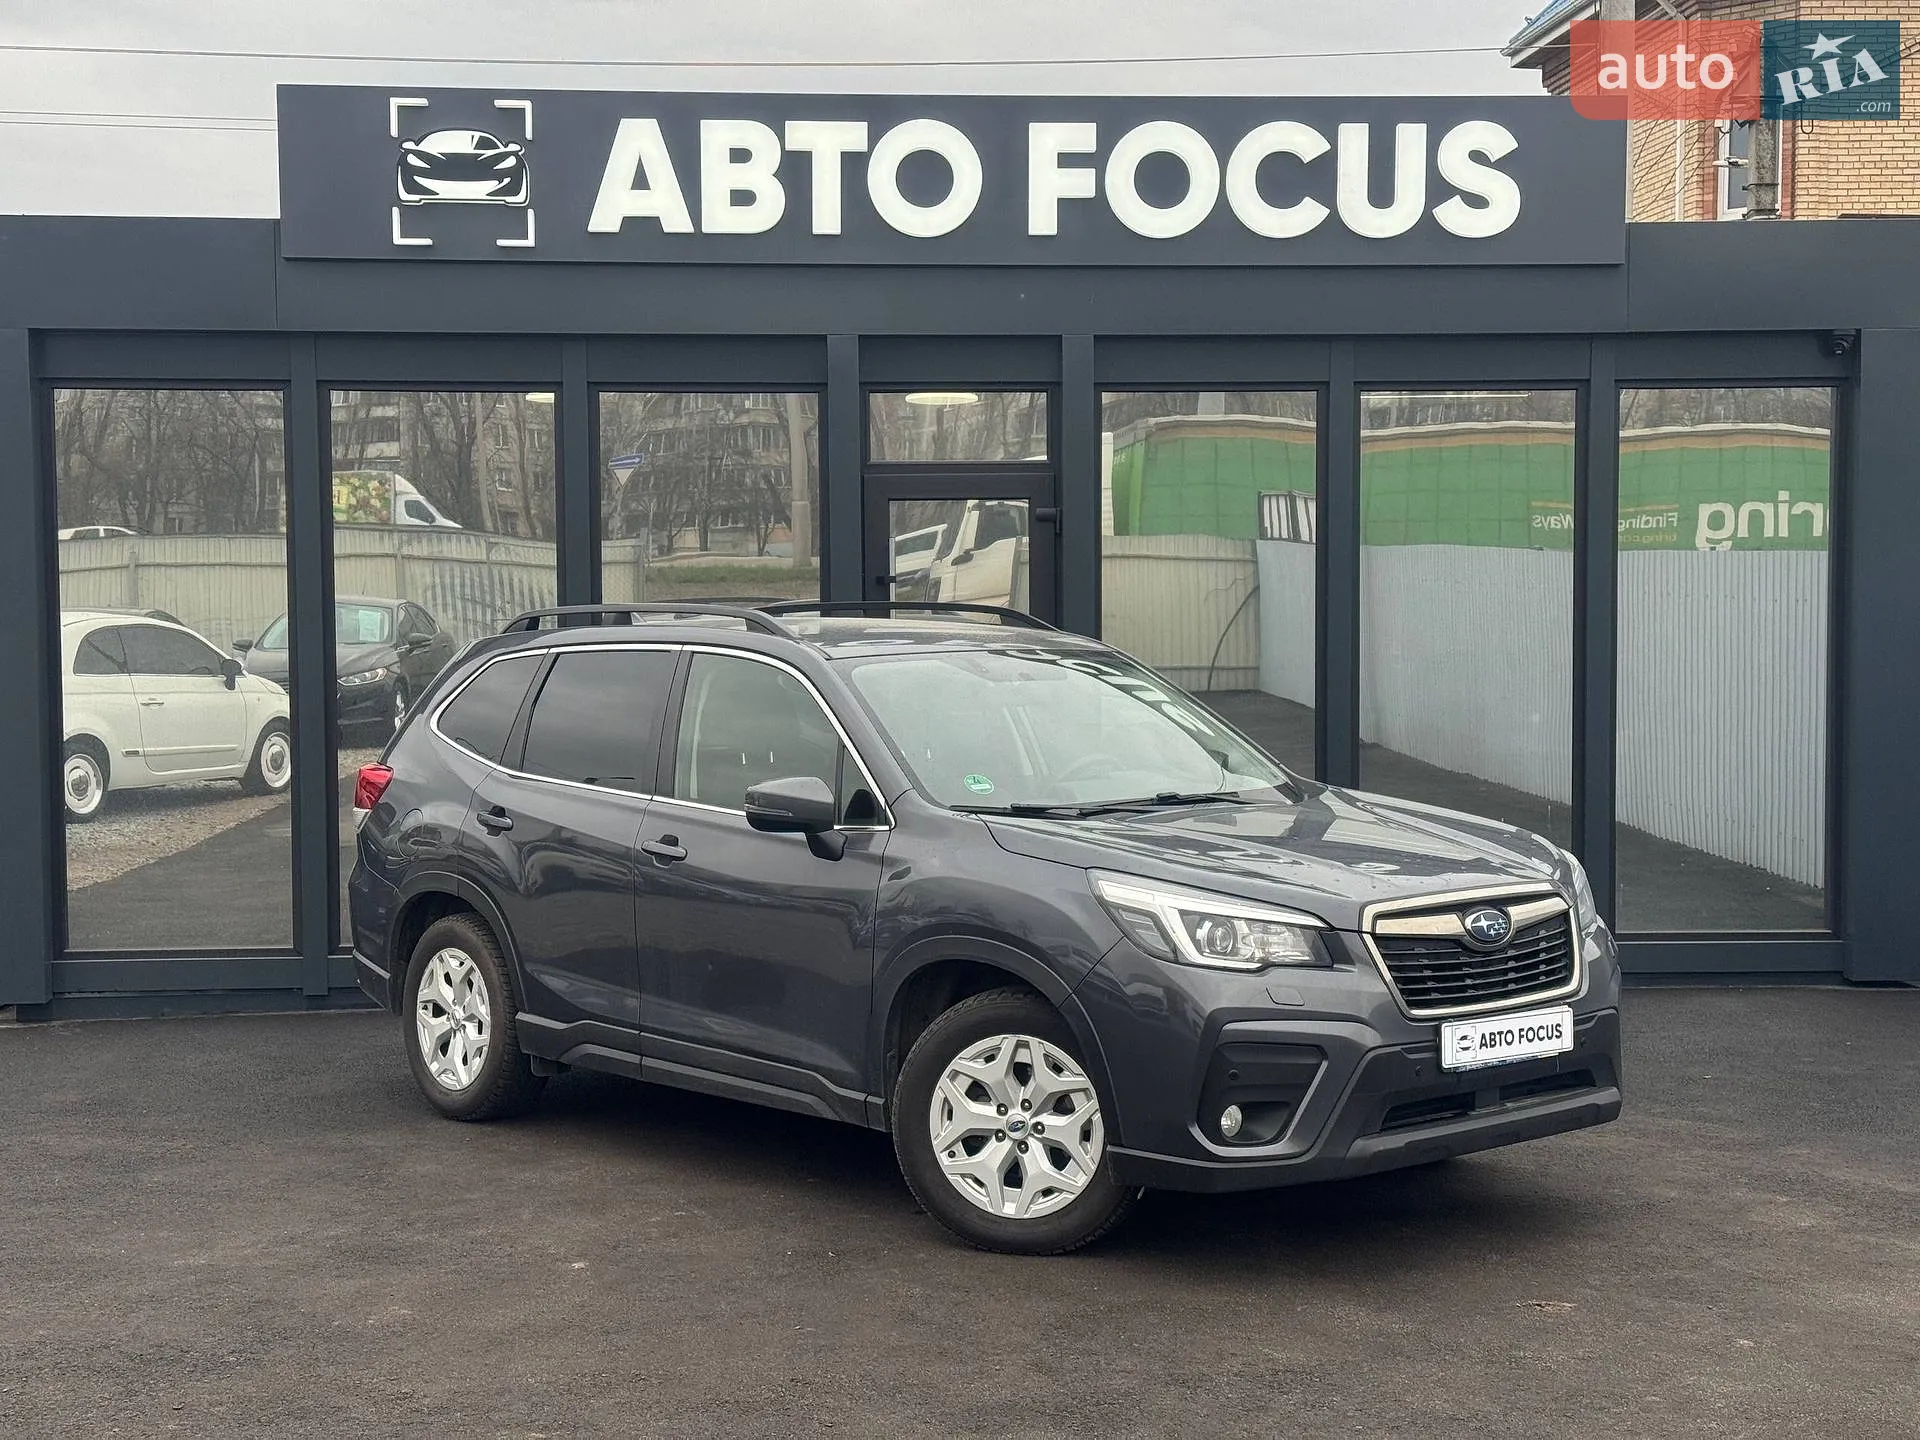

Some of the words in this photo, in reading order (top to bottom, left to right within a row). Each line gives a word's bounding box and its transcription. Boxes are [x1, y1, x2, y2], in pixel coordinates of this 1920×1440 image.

[587, 118, 983, 238] АВТО
[1028, 120, 1521, 239] FOCUS
[1479, 1029, 1515, 1050] АВТО
[1518, 1023, 1563, 1045] FOCUS
